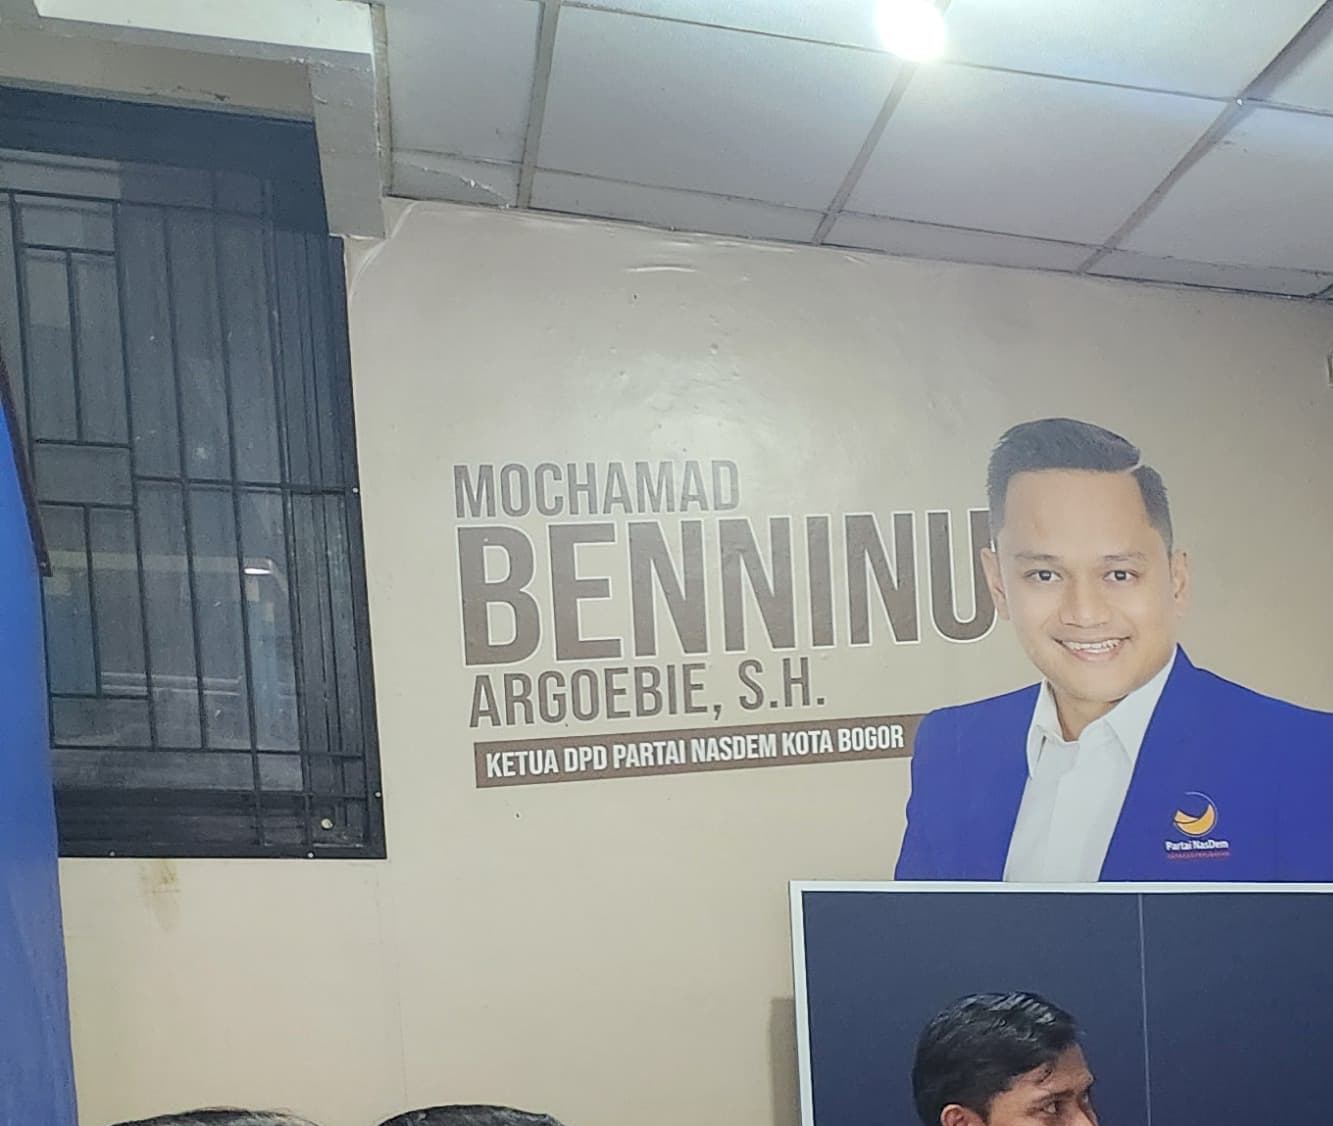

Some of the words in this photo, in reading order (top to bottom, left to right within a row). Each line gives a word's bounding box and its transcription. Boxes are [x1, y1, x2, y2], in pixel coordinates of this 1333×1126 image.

[453, 459, 741, 518] MOCHAMAD
[457, 508, 998, 666] BENNINU
[469, 663, 722, 728] ARGOEBIE,
[738, 657, 826, 711] S.H.
[486, 748, 558, 778] KETUA
[564, 745, 607, 773] DPD
[613, 738, 686, 769] PARTAI
[690, 733, 777, 763] NASDEM
[782, 728, 834, 756] KOTA
[838, 724, 905, 752] BOGOR
[1165, 841, 1192, 851] Partai
[1193, 839, 1229, 849] NasDem
